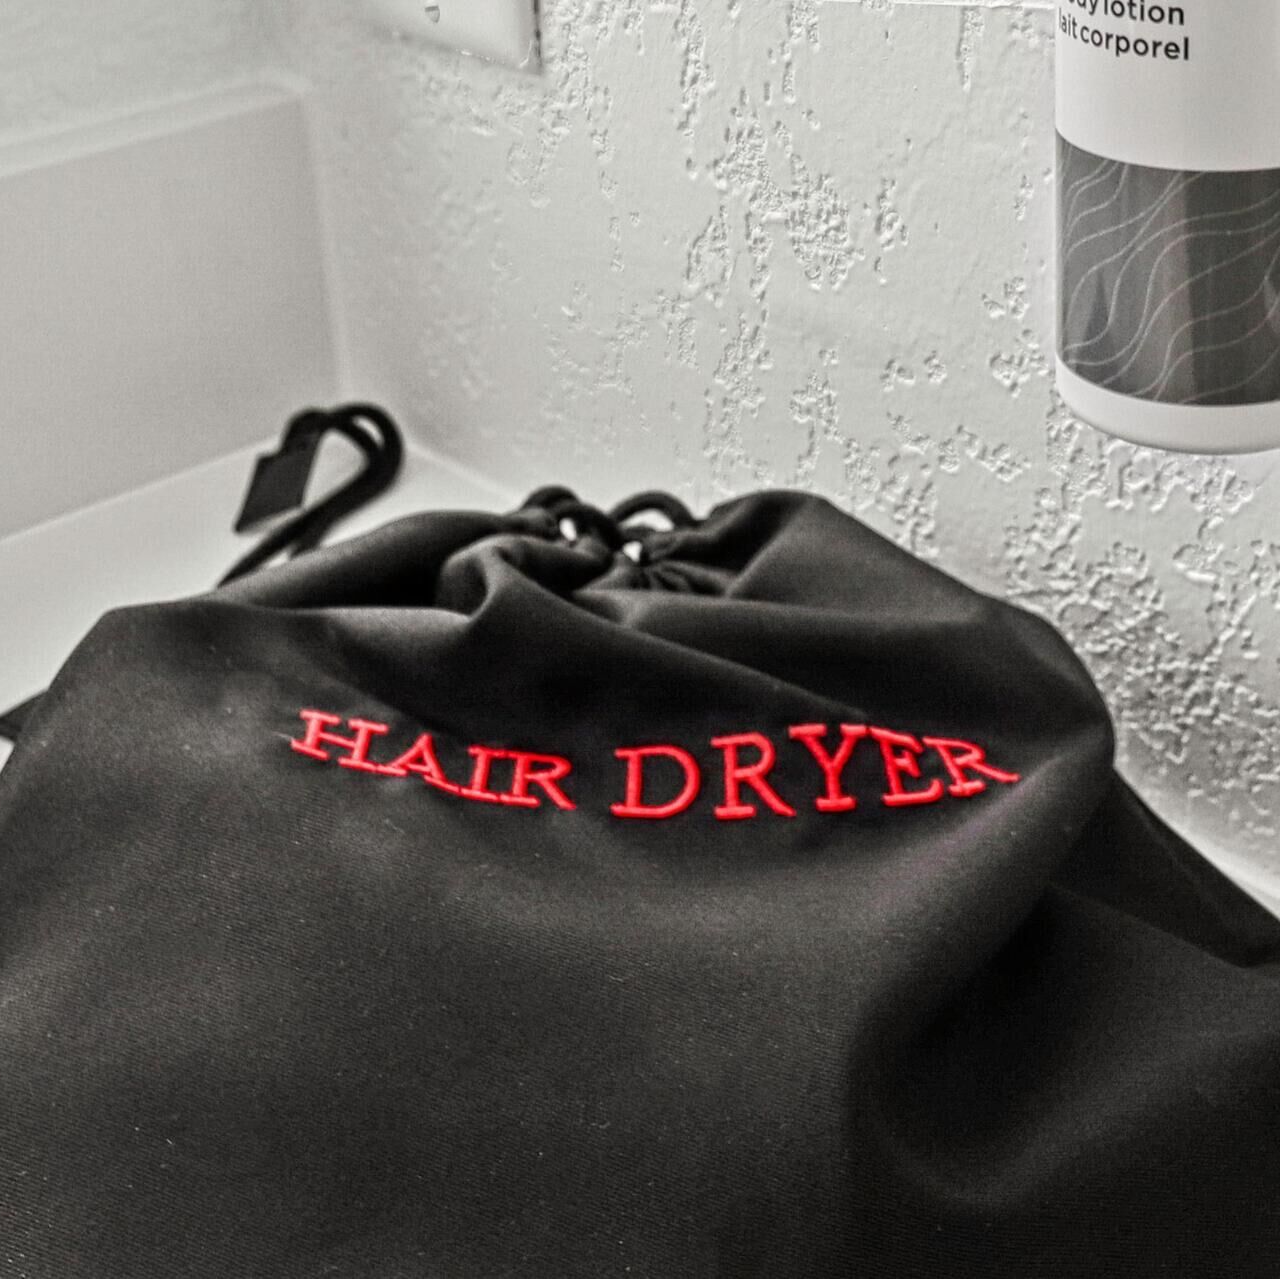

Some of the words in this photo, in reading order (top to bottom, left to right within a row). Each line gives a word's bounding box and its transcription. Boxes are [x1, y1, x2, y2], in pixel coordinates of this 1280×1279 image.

[1058, 7, 1078, 40] lait
[1079, 25, 1190, 61] corporel
[291, 709, 577, 811] HAIR
[609, 722, 1020, 820] DRYER
